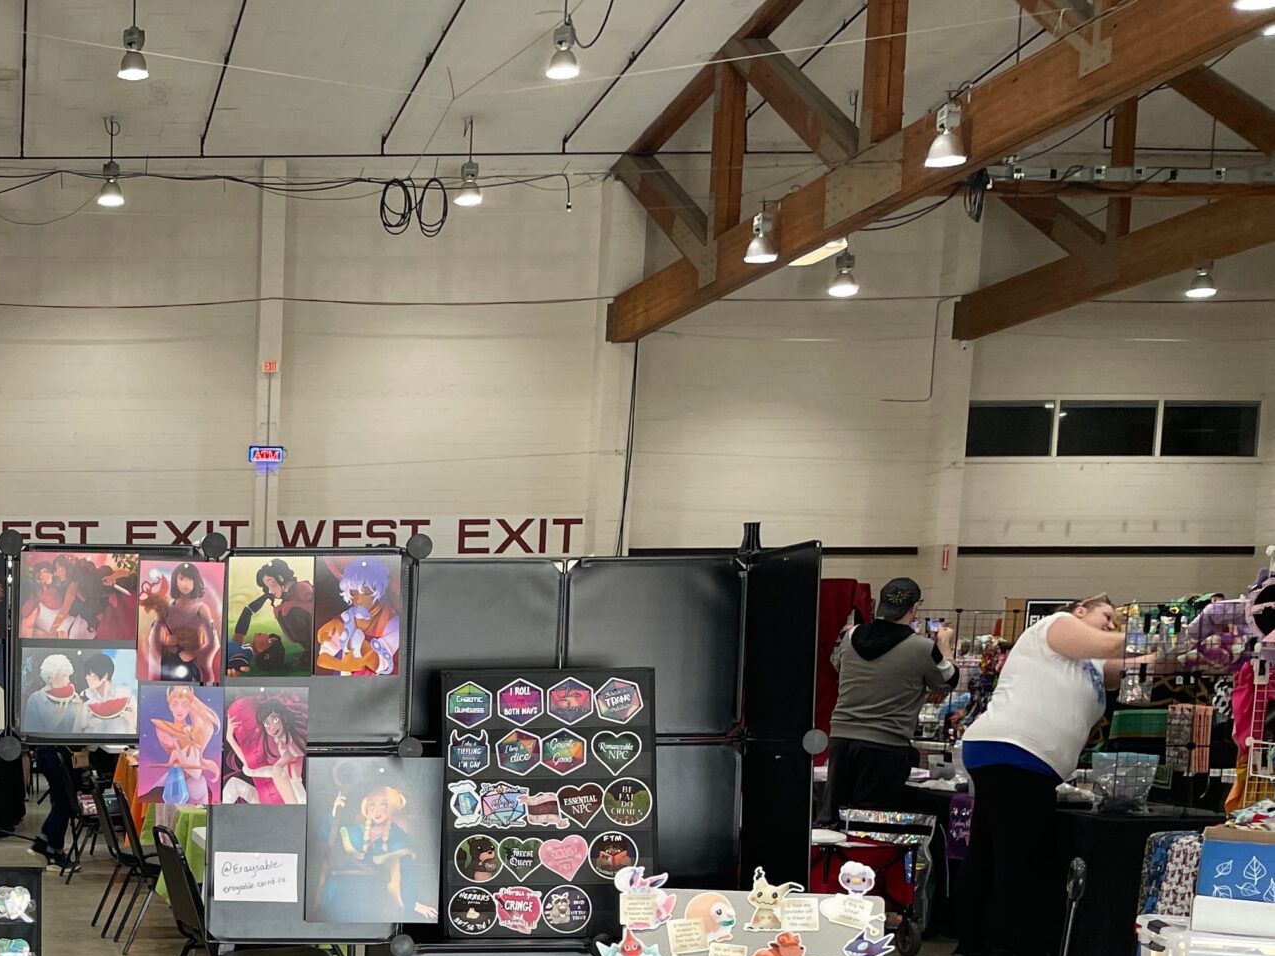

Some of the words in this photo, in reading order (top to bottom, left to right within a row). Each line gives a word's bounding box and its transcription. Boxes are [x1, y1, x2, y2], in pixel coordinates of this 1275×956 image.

[254, 450, 279, 461] ATM
[457, 518, 583, 554] EXIT
[514, 686, 531, 695] ROLL
[510, 753, 531, 763] dice
[608, 750, 629, 760] NPC
[563, 795, 598, 806] ESSENTIAL
[572, 803, 593, 815] NPC
[221, 860, 284, 878] @Eraysable
[505, 900, 534, 912] CRINGE
